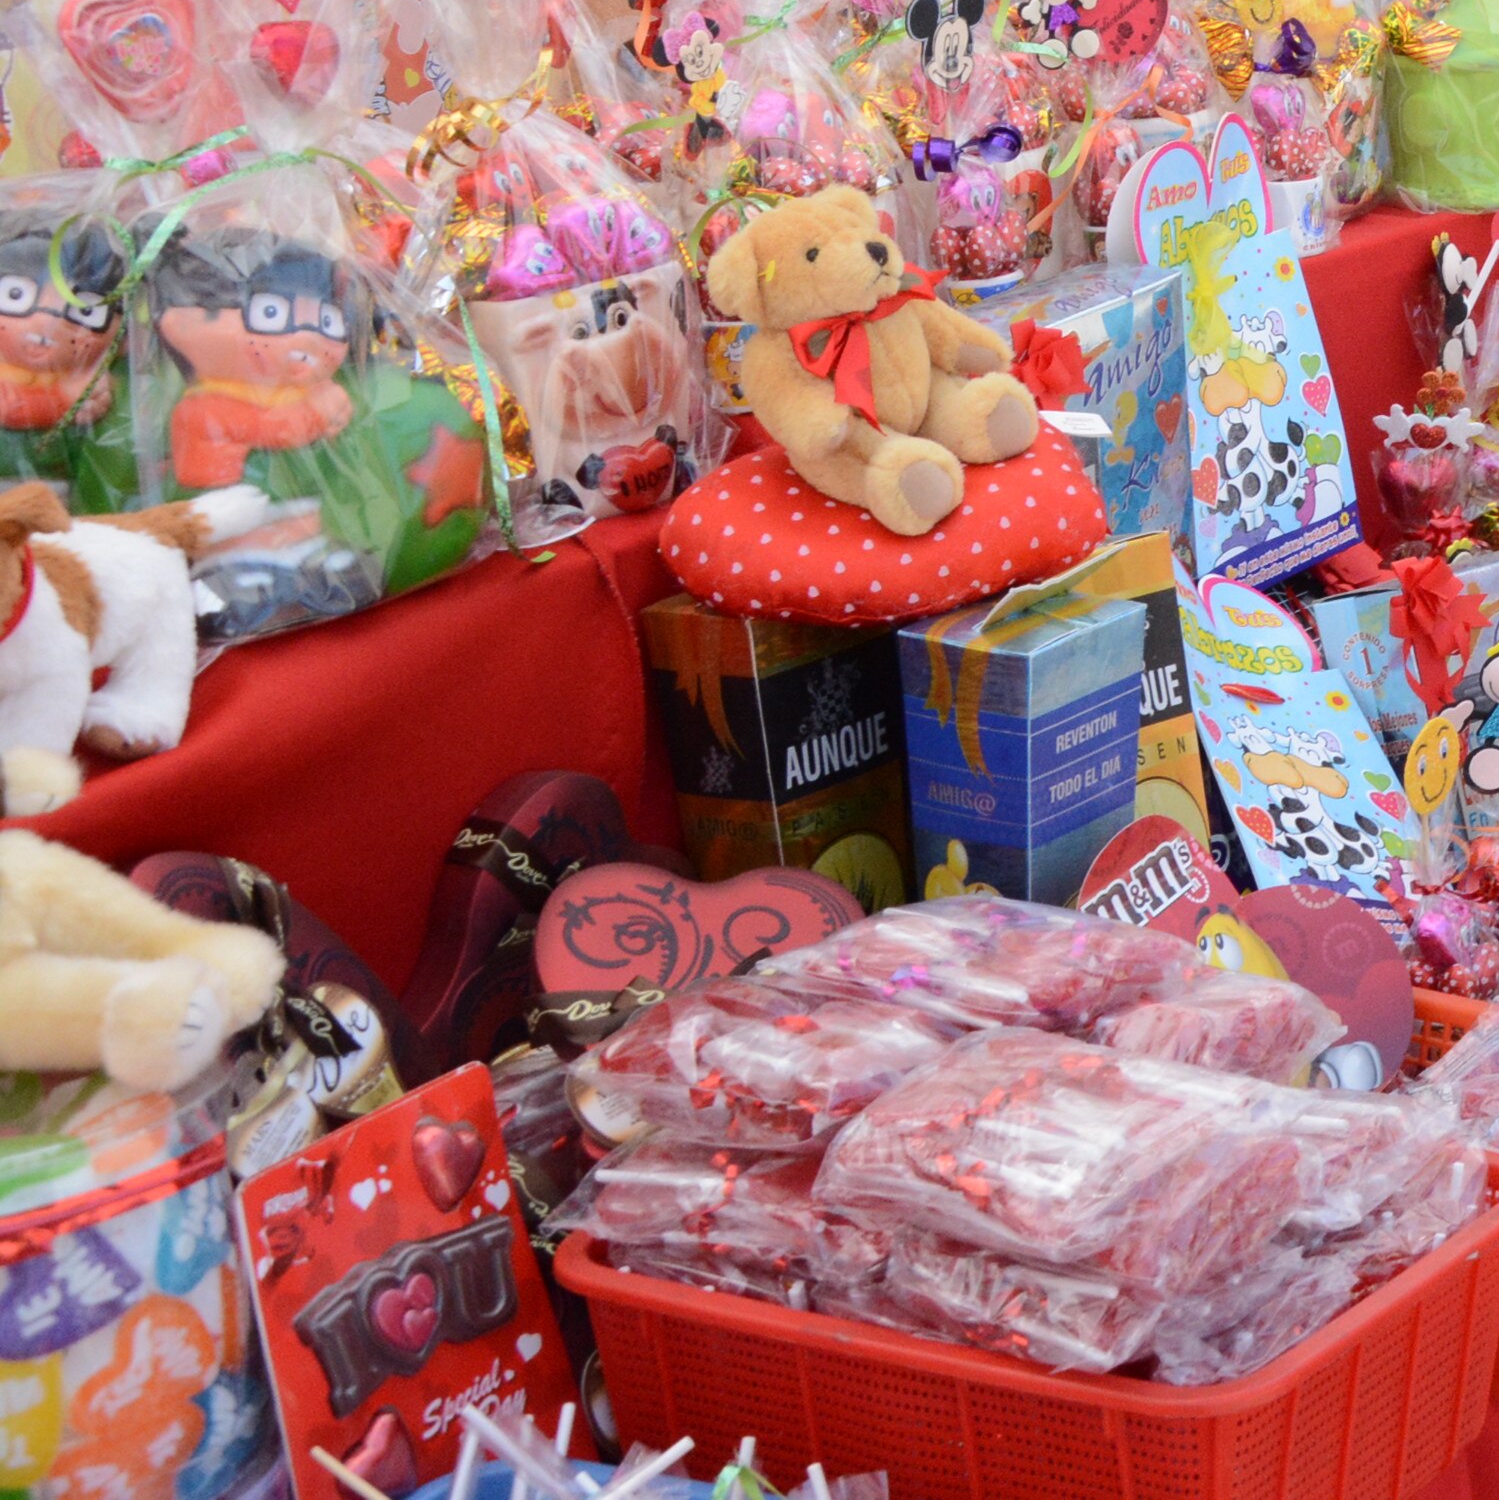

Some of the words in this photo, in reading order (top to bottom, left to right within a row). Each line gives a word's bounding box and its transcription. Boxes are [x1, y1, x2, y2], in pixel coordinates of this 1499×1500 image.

[1146, 180, 1198, 212] Amo
[1342, 631, 1387, 662] CONTENIDO
[1360, 646, 1376, 678] 1
[784, 710, 891, 791] AUNQUE
[1054, 710, 1118, 755] REVENTON
[927, 779, 997, 816] AMIG@
[1048, 773, 1083, 805] TODO
[1084, 769, 1100, 793] EL
[1101, 754, 1122, 786] DIA
[507, 850, 549, 881] Dove
[422, 1357, 501, 1441] Special
